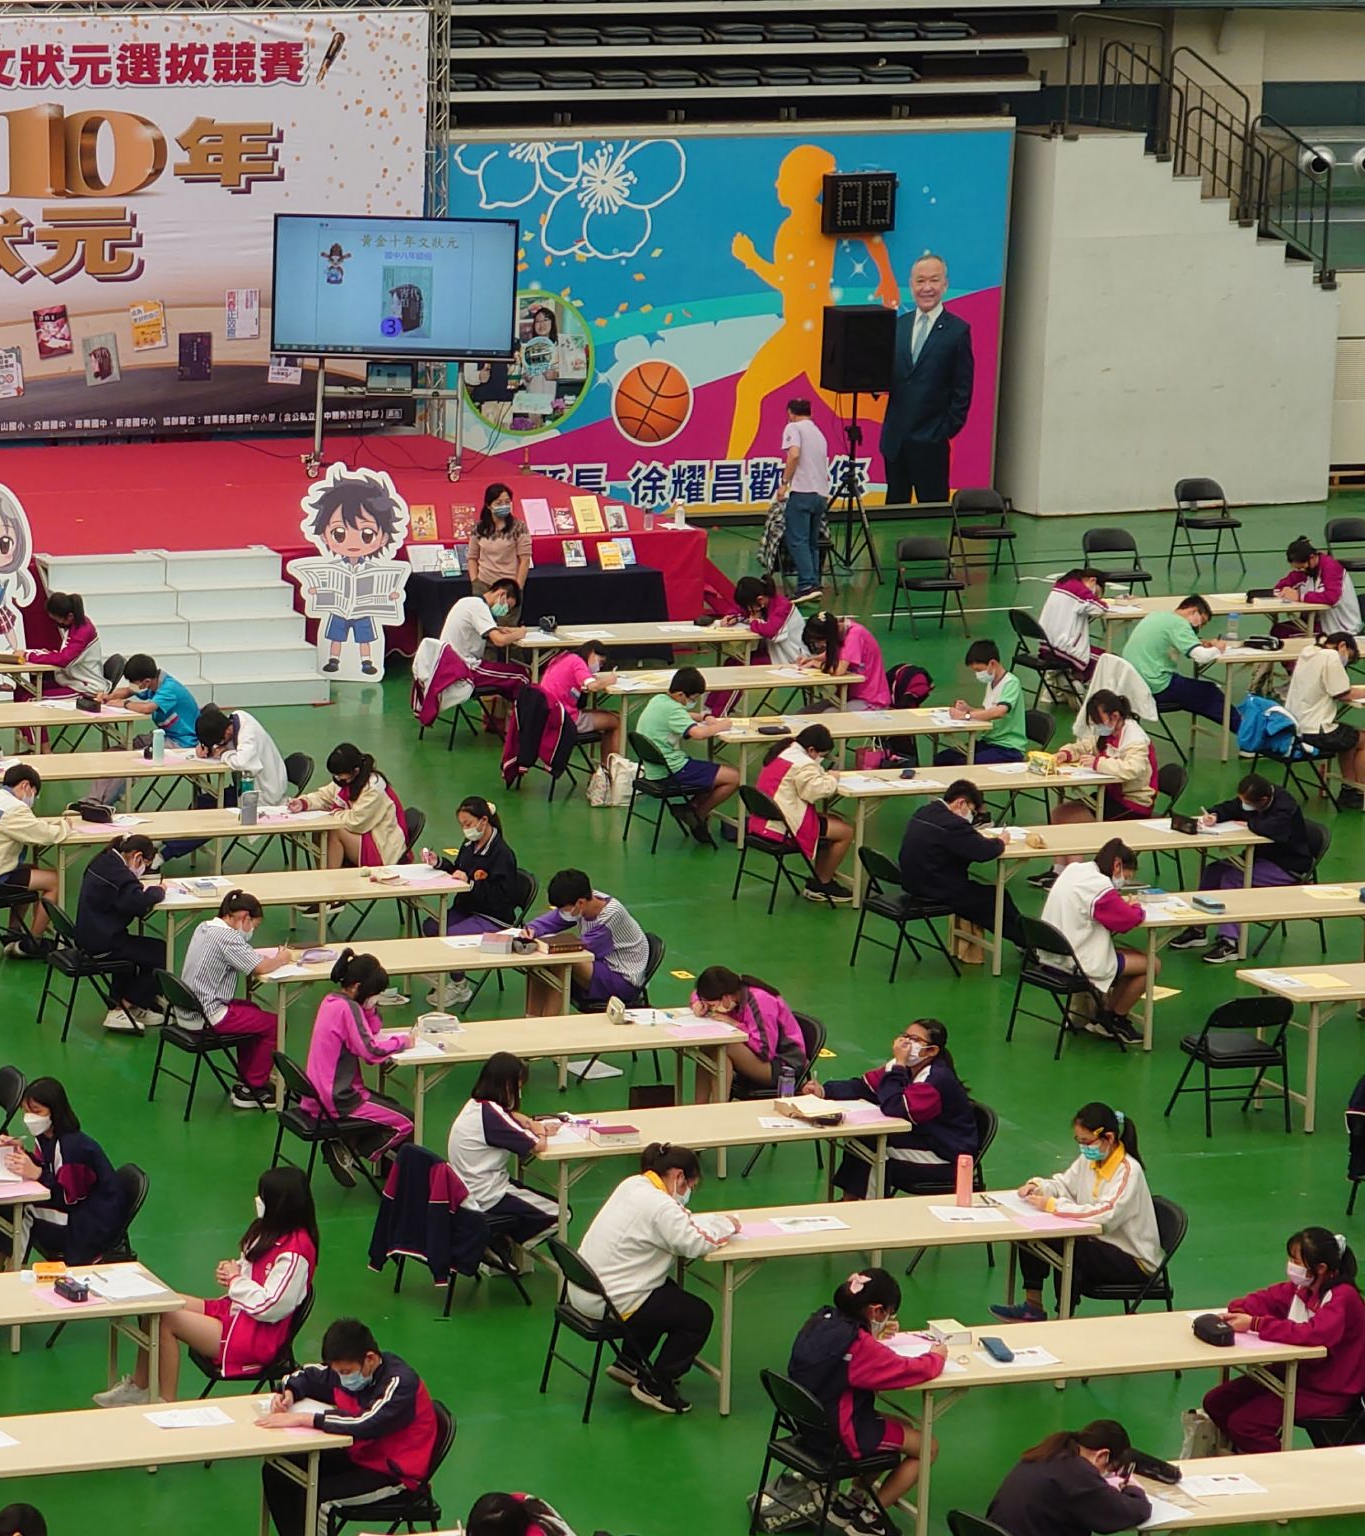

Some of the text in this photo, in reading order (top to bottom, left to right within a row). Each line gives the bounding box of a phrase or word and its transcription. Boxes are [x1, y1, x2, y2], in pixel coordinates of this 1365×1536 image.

[360, 234, 460, 249] 黃金十年文狀元
[386, 319, 396, 335] 3
